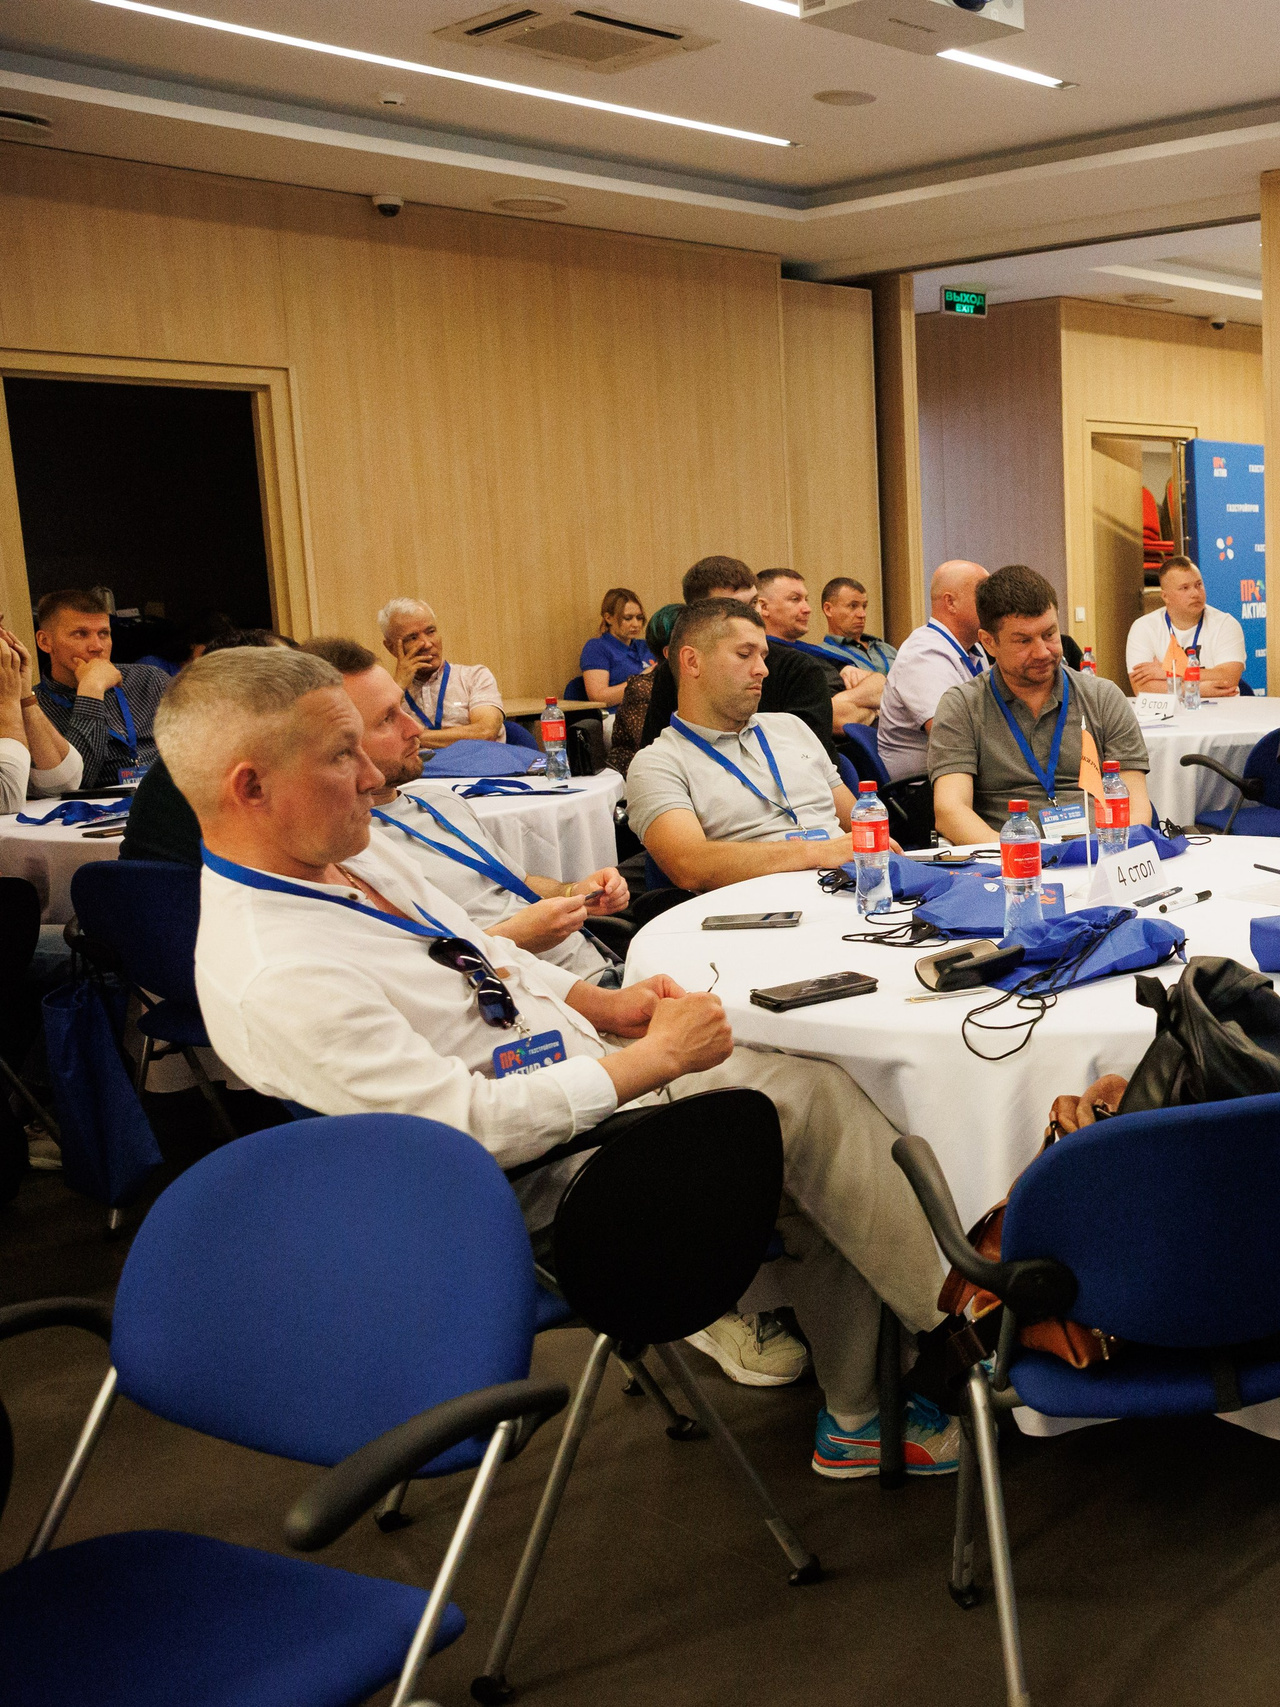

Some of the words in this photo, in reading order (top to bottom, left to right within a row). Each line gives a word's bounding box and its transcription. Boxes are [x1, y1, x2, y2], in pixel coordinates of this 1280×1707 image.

[945, 291, 985, 307] ВЫХОД
[955, 303, 975, 314] EXIT
[1141, 698, 1147, 709] 9
[1149, 700, 1168, 710] стол
[1117, 865, 1127, 887] 4
[1128, 860, 1156, 883] стол
